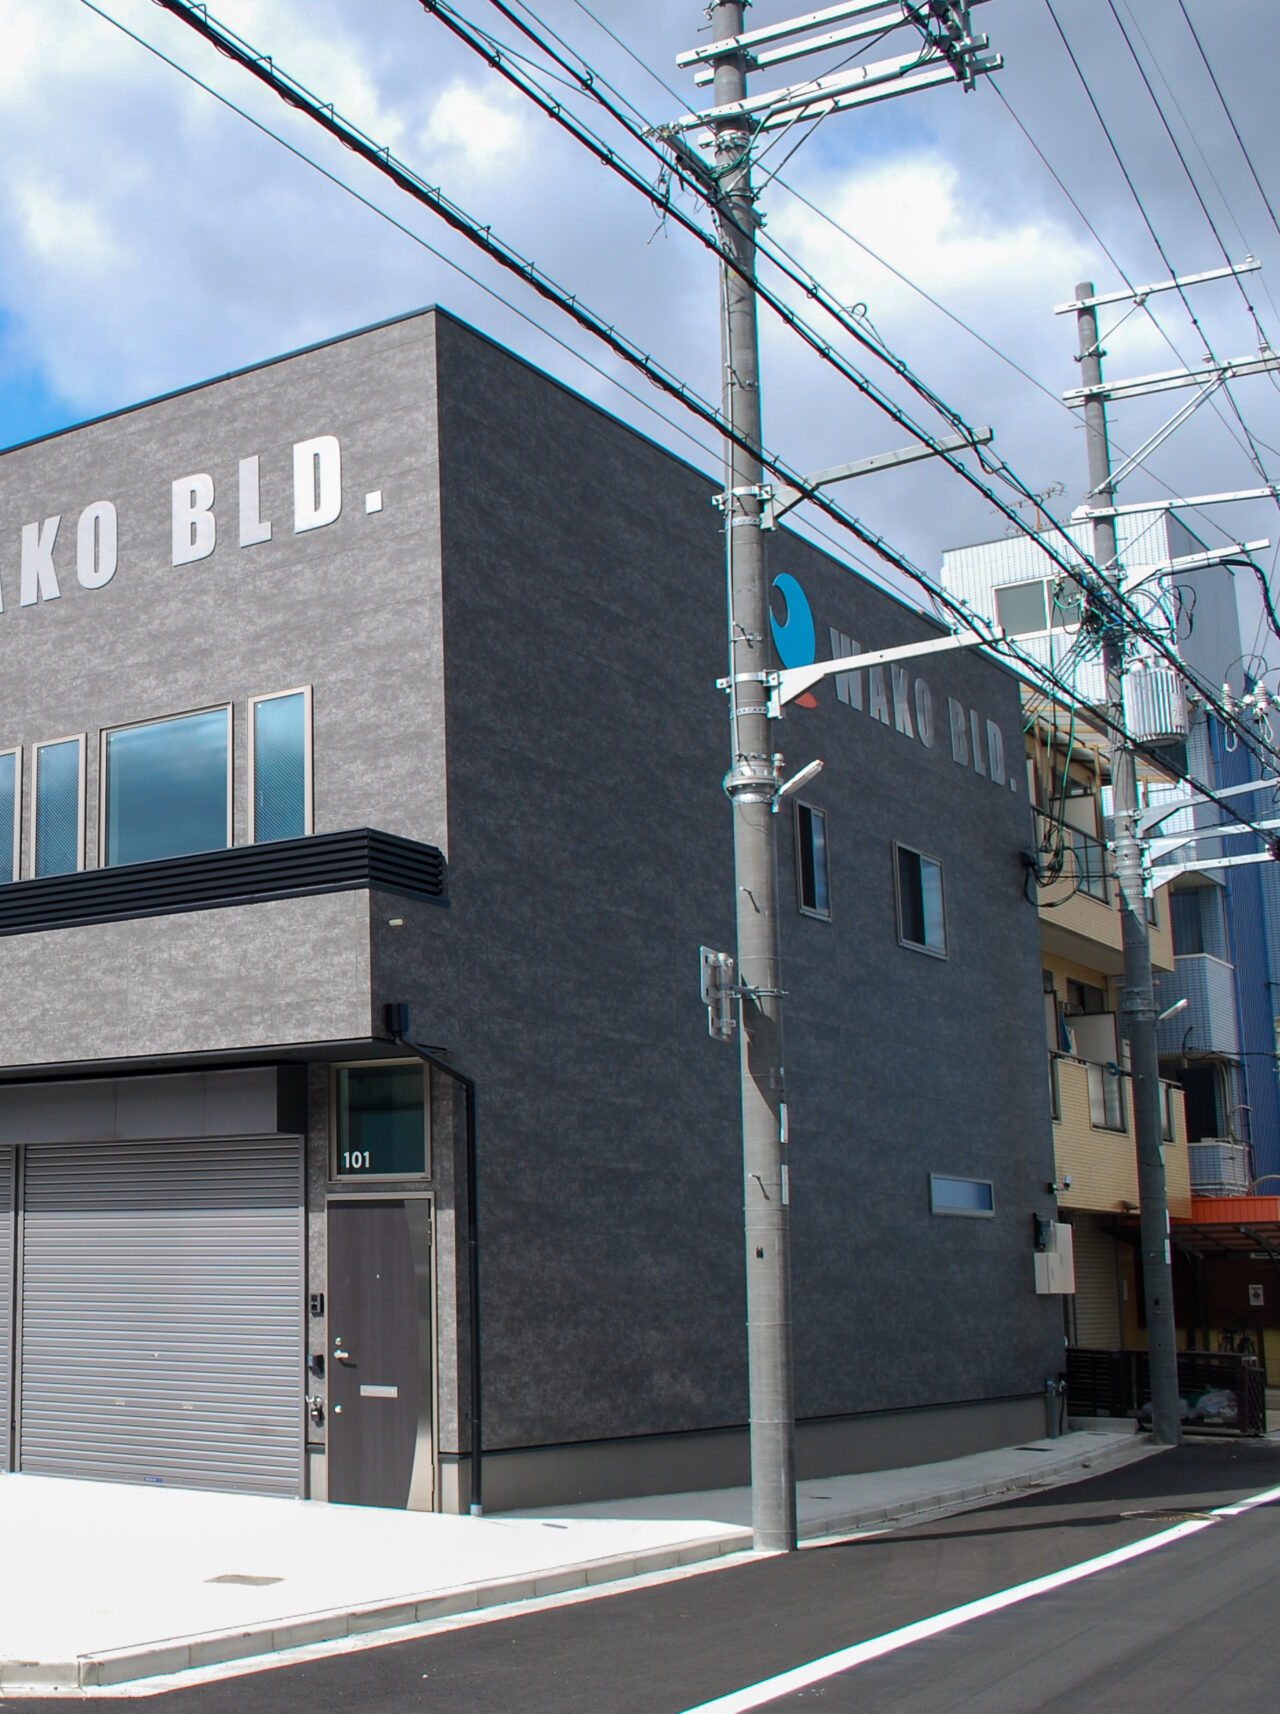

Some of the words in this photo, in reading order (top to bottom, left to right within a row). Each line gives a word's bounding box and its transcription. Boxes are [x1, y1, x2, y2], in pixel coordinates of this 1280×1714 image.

[172, 435, 383, 567] BLD.
[829, 626, 935, 749] WAKO
[948, 696, 1018, 793] BLD.
[343, 1151, 371, 1169] 101
